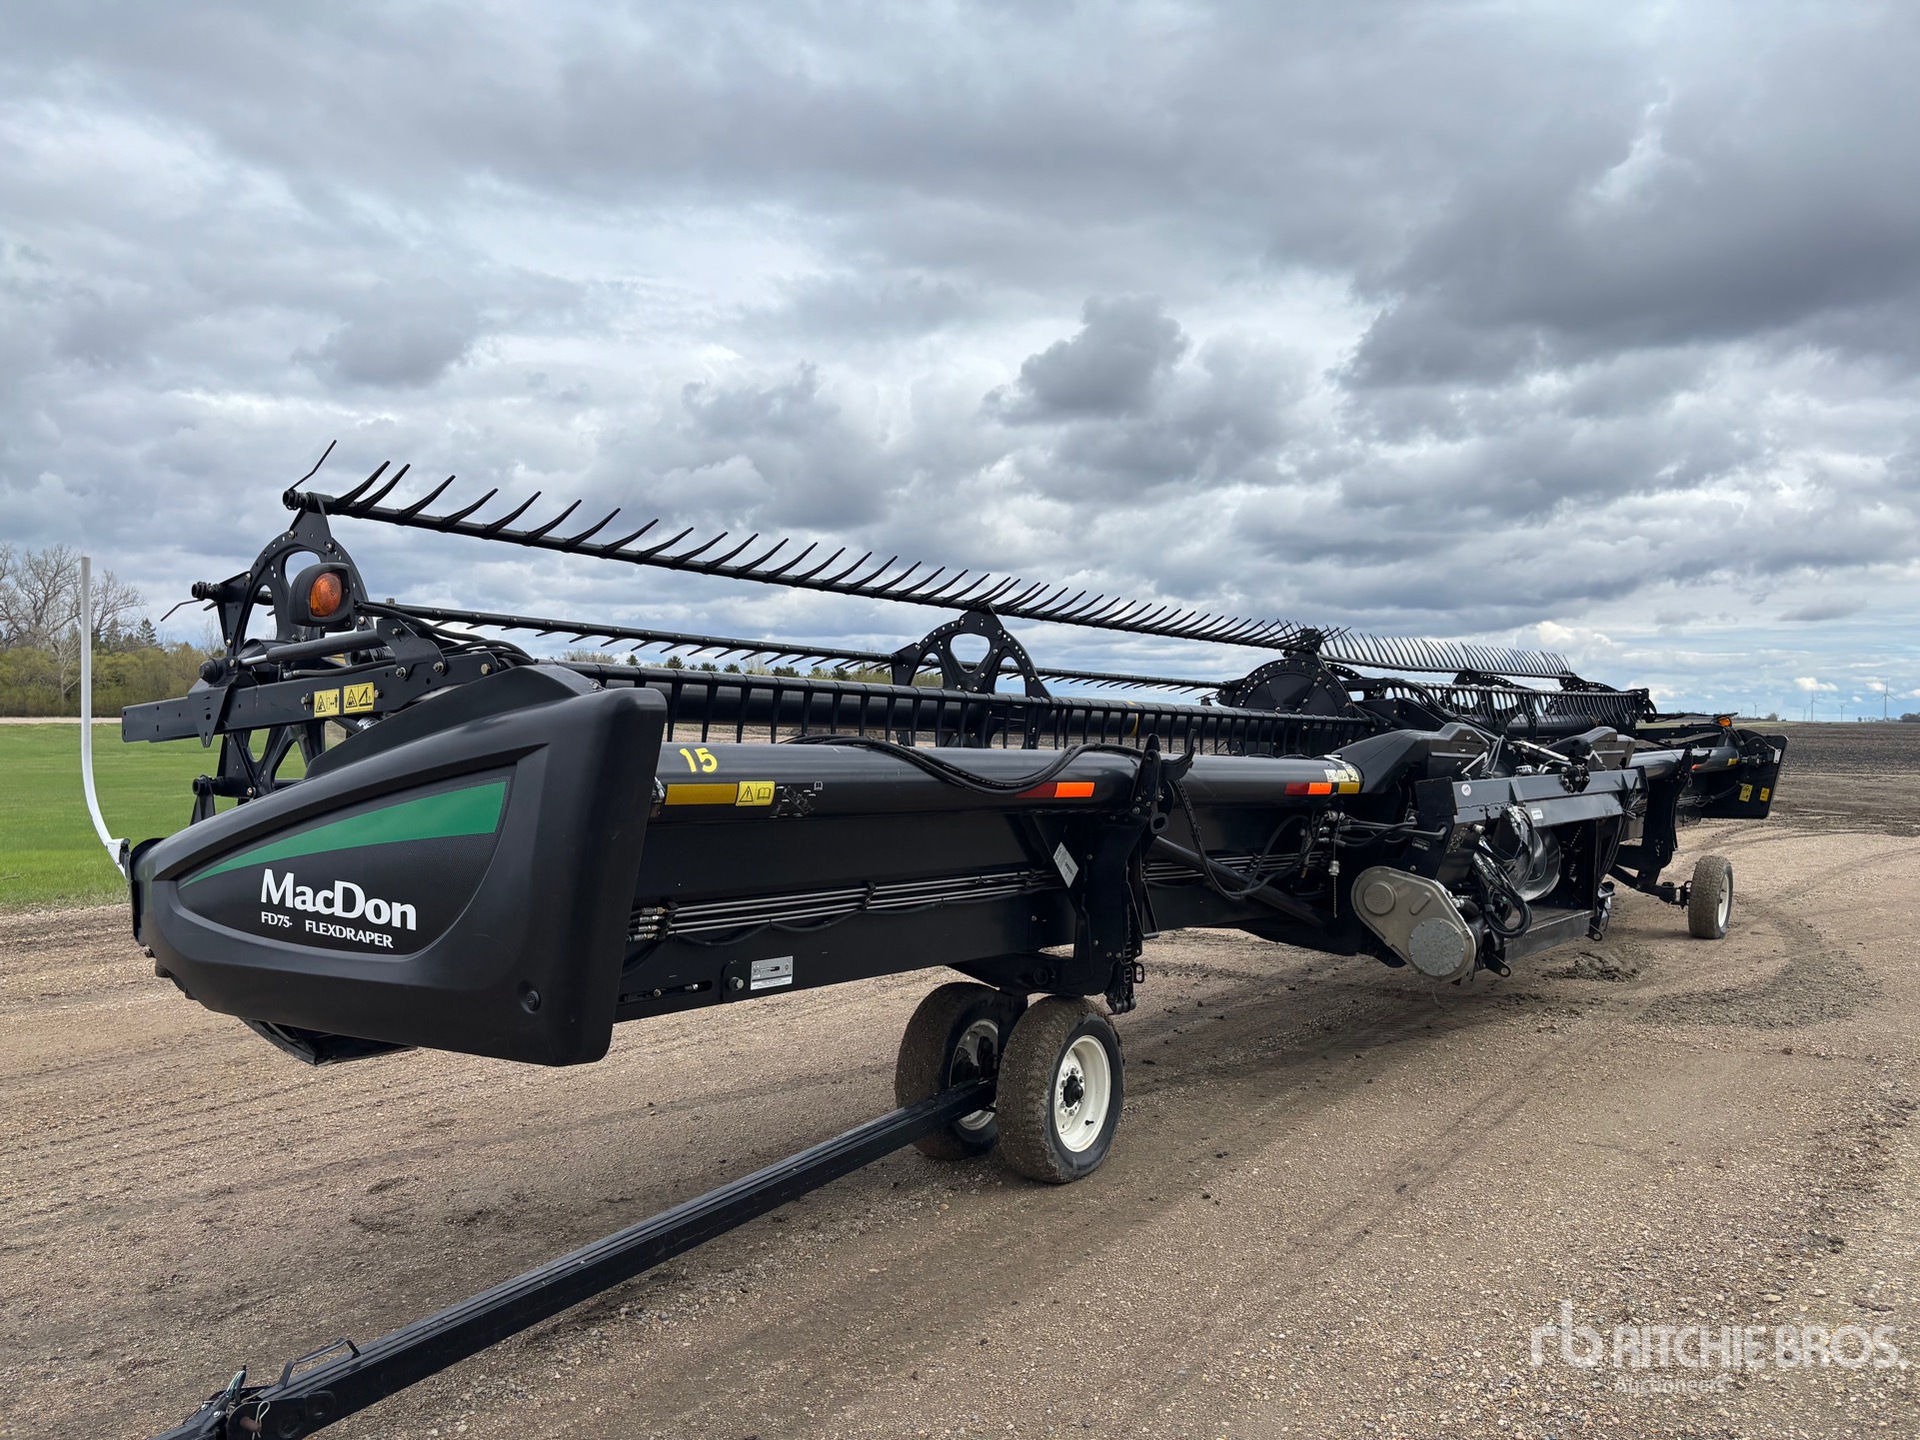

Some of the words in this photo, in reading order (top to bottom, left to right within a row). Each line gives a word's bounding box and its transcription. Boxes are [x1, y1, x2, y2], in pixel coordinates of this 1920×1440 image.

[679, 747, 718, 773] 15
[260, 868, 417, 931] MacDon
[305, 919, 394, 949] FLEXDRAPER
